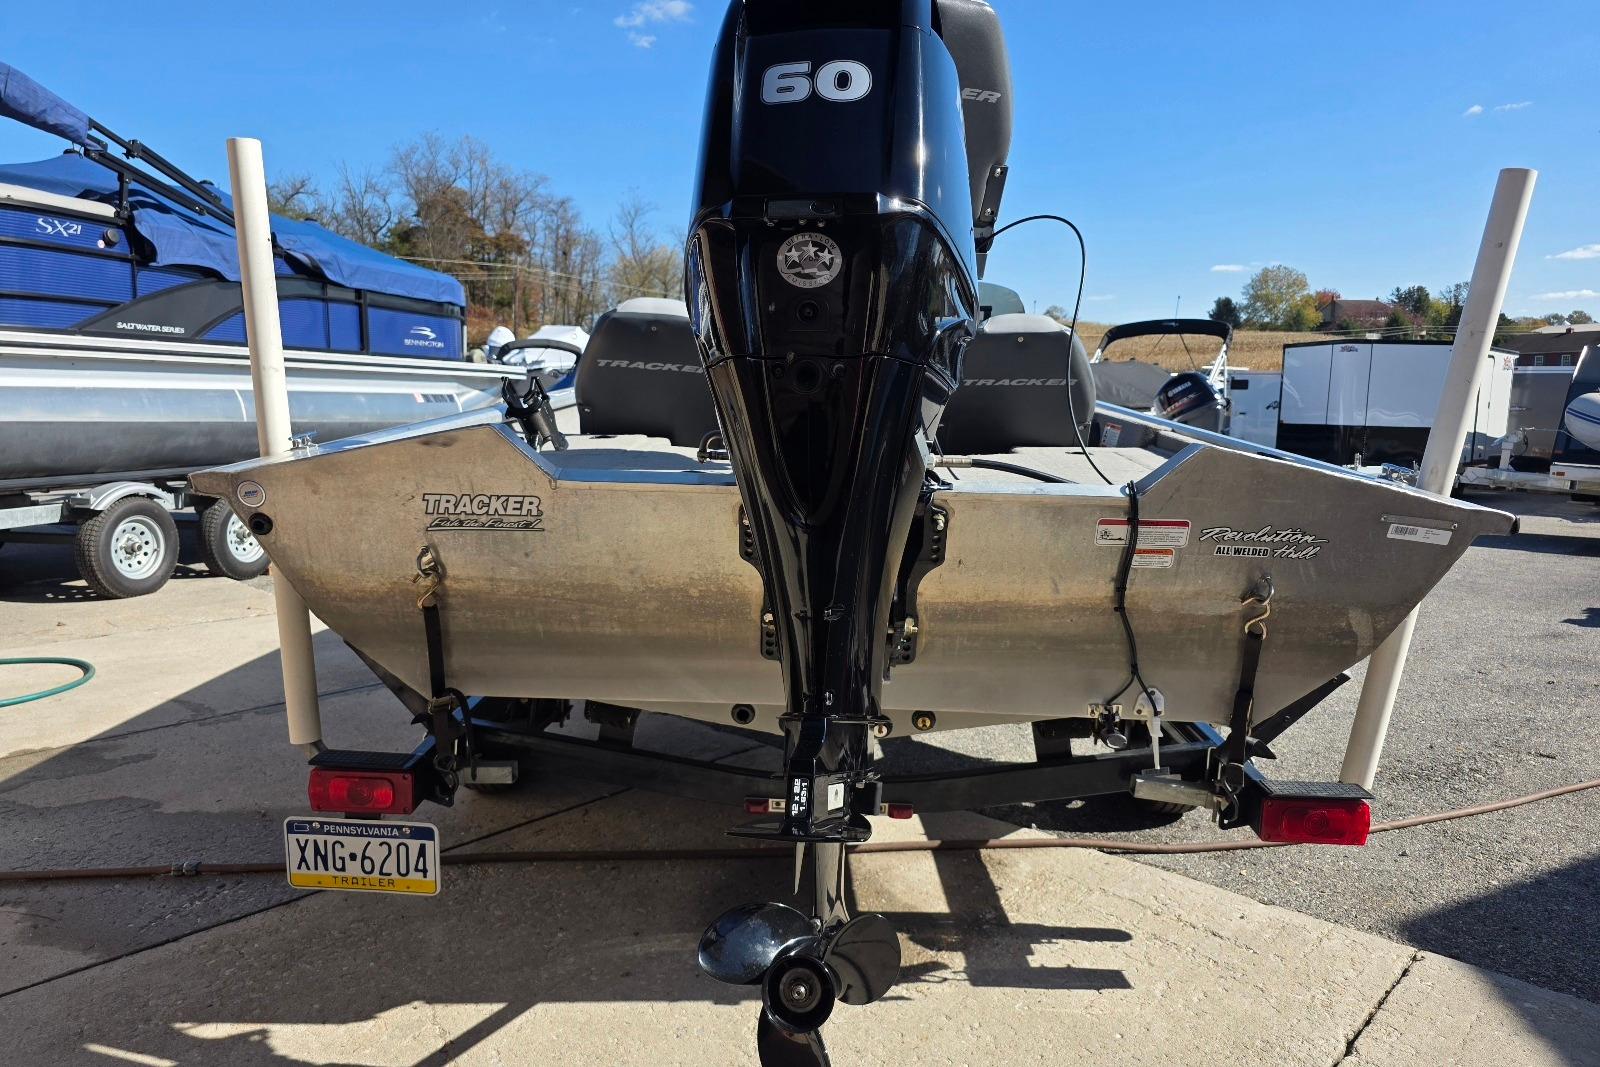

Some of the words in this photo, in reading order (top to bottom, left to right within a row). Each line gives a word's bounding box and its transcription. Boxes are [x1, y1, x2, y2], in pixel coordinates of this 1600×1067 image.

[760, 60, 872, 105] 60
[36, 218, 82, 237] SX21
[117, 321, 161, 331] SALTWATER
[404, 339, 444, 348] BENNINGTON
[963, 378, 1079, 386] TRACKER
[422, 493, 541, 516] TRACKER
[431, 517, 460, 528] Fish
[463, 519, 482, 528] the
[1199, 525, 1329, 544] Revolution
[1215, 546, 1231, 556] ALL
[1233, 547, 1269, 557] WELDED
[1273, 544, 1321, 560] Hull
[792, 803, 799, 816] 12
[323, 825, 399, 836] PENNSYLVANIA
[332, 876, 396, 887] TRAILER
